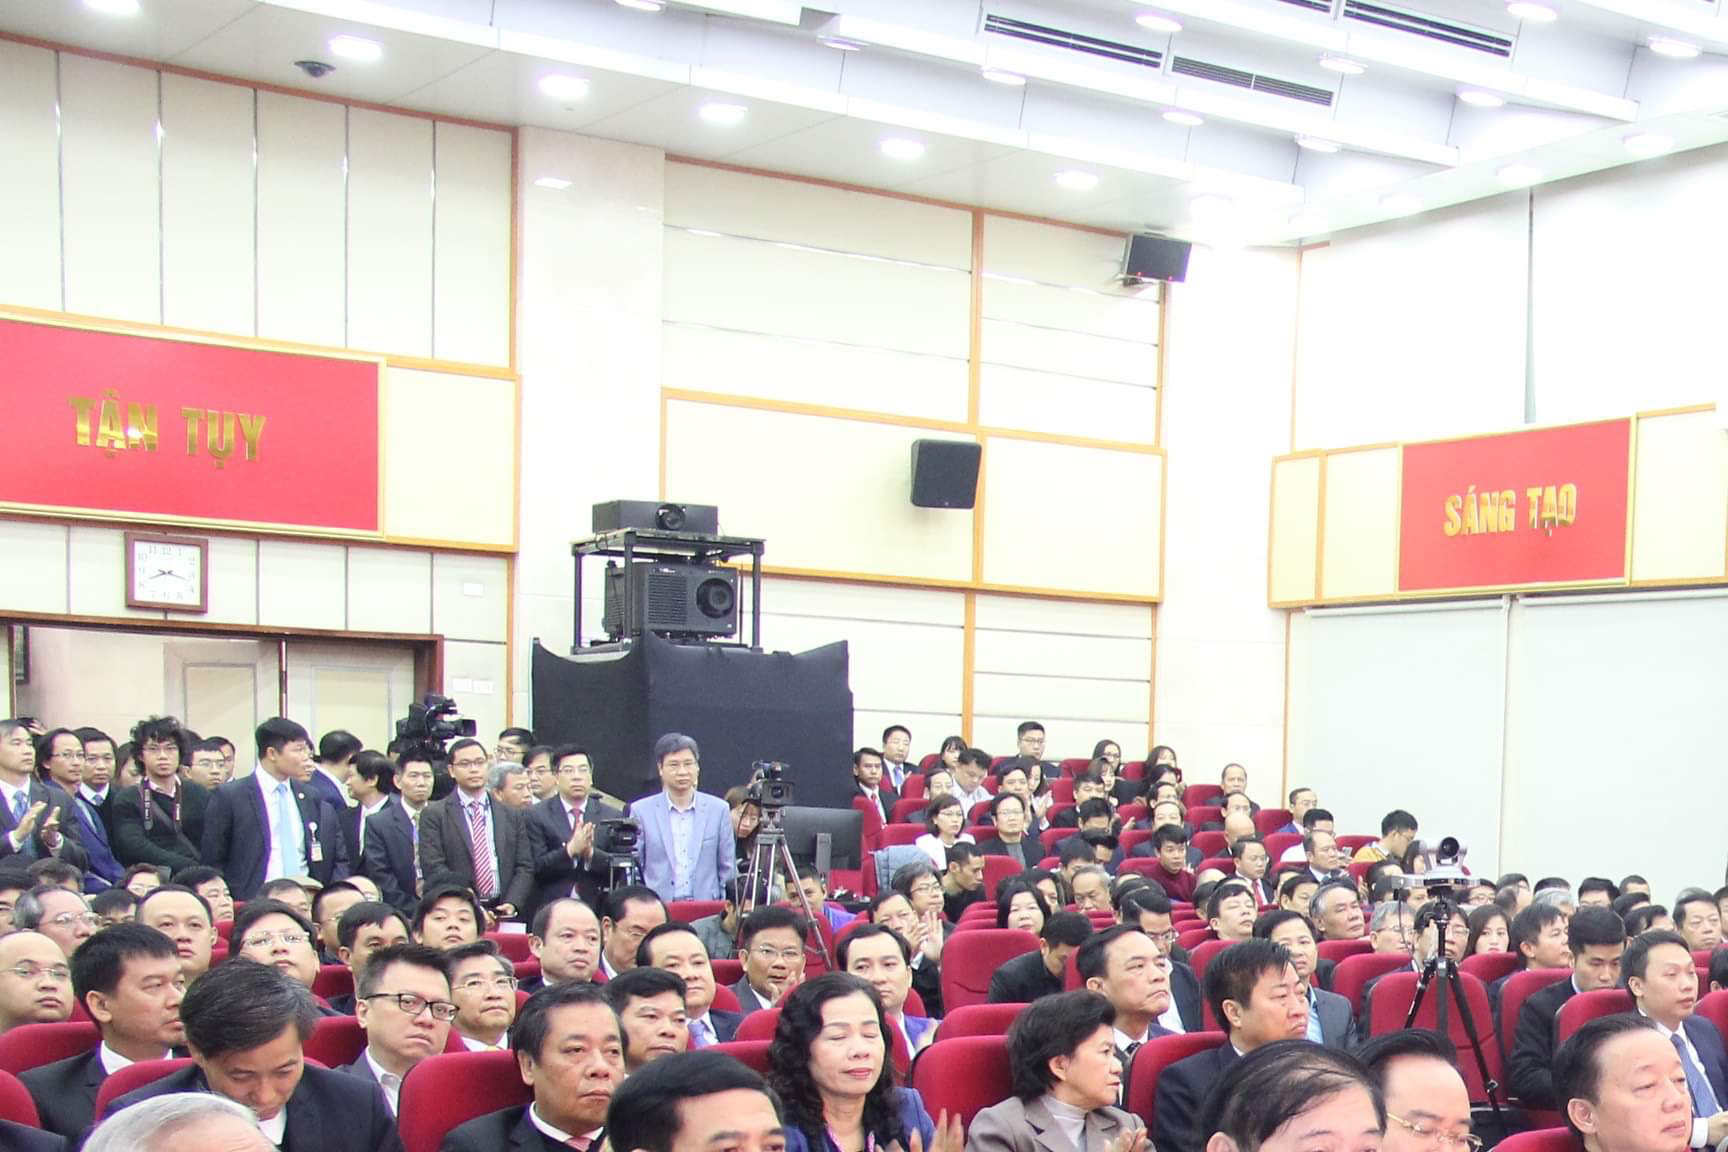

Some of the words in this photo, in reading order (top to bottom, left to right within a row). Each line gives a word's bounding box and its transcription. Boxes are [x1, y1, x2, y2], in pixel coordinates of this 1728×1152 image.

[69, 388, 158, 458] TẬN
[180, 406, 267, 469] TỤY
[1443, 485, 1516, 537] SÁNG
[1526, 483, 1577, 537] TẠO
